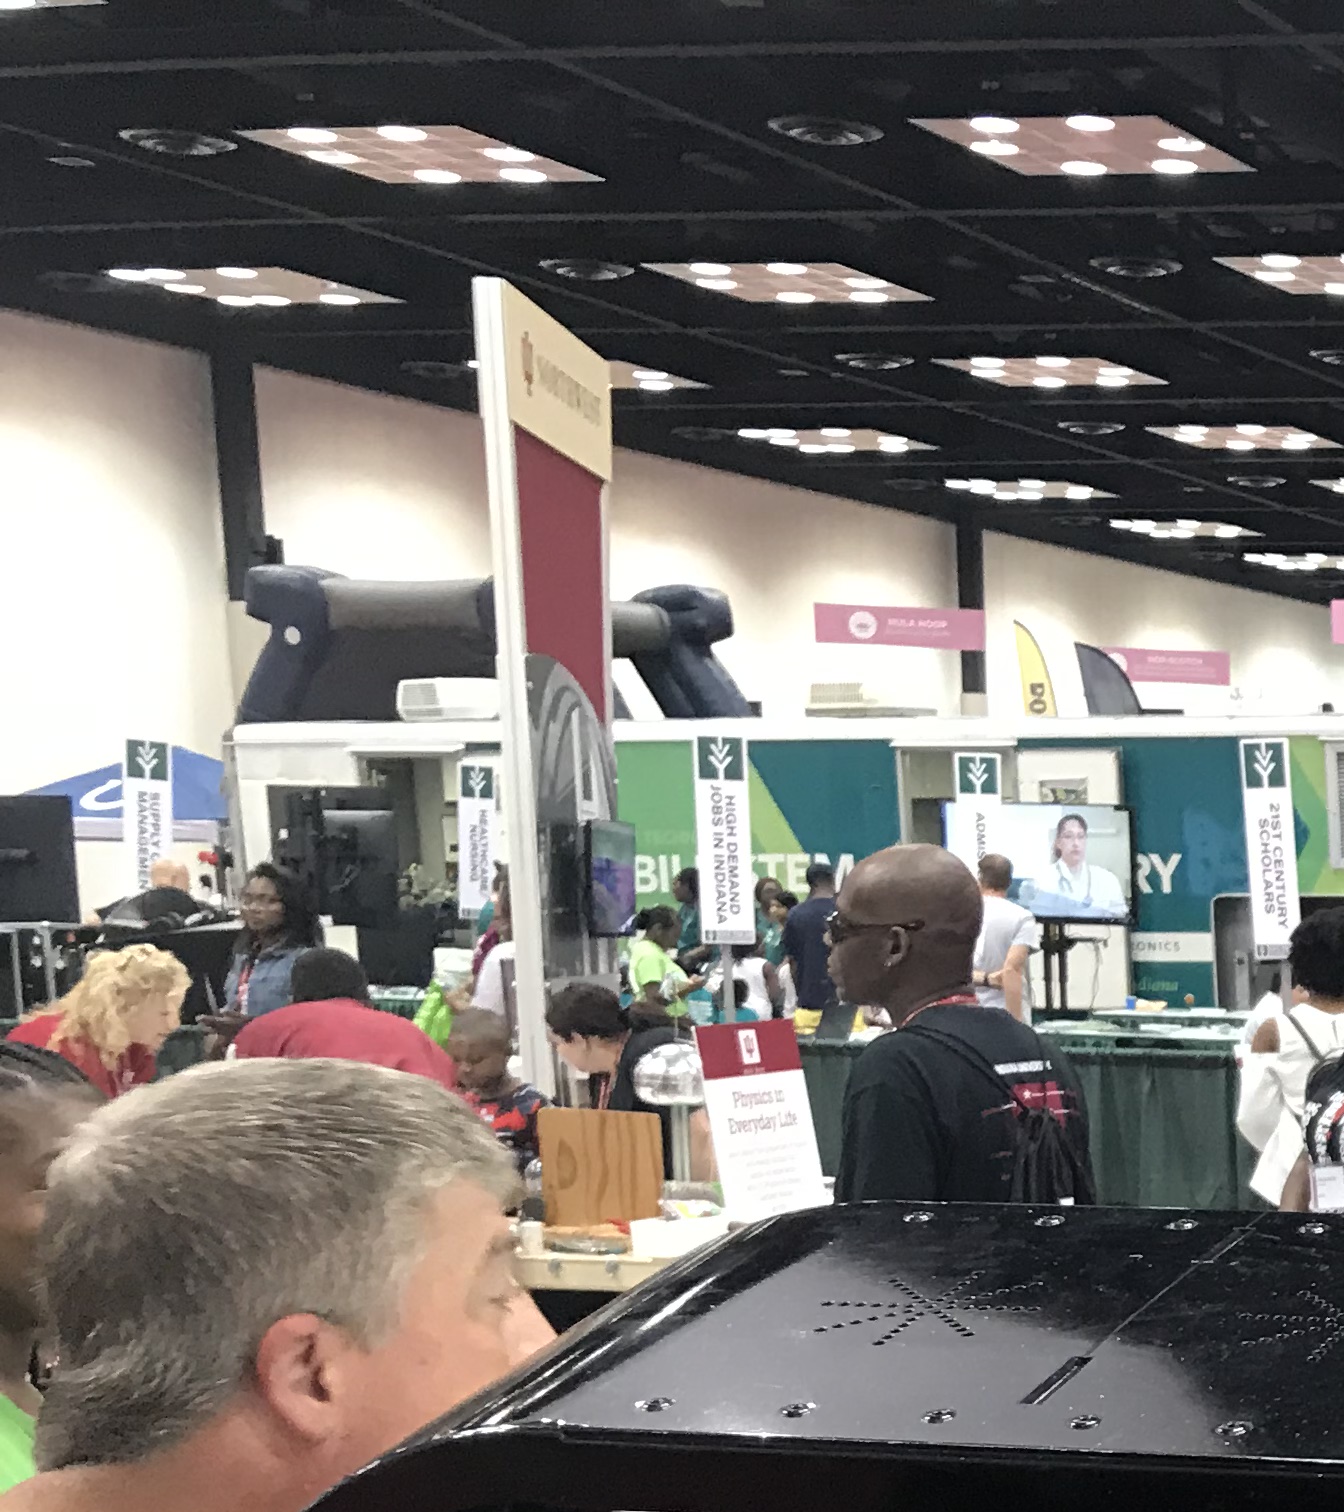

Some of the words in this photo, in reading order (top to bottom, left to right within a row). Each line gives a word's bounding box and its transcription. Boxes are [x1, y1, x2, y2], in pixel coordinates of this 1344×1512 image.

[709, 784, 724, 828] JOBS
[724, 794, 738, 838] HIGH
[1269, 802, 1282, 842] 21ST
[137, 790, 150, 890] MANAGEMEN
[713, 831, 725, 849] IN
[975, 812, 987, 860] ADMIS
[726, 842, 741, 916] DEMAND
[1258, 817, 1276, 915] SCHOLARS
[1272, 848, 1289, 930] CENTURY
[714, 855, 728, 925] INDIANA
[732, 1091, 773, 1110] Physics
[728, 1114, 777, 1135] Everyday
